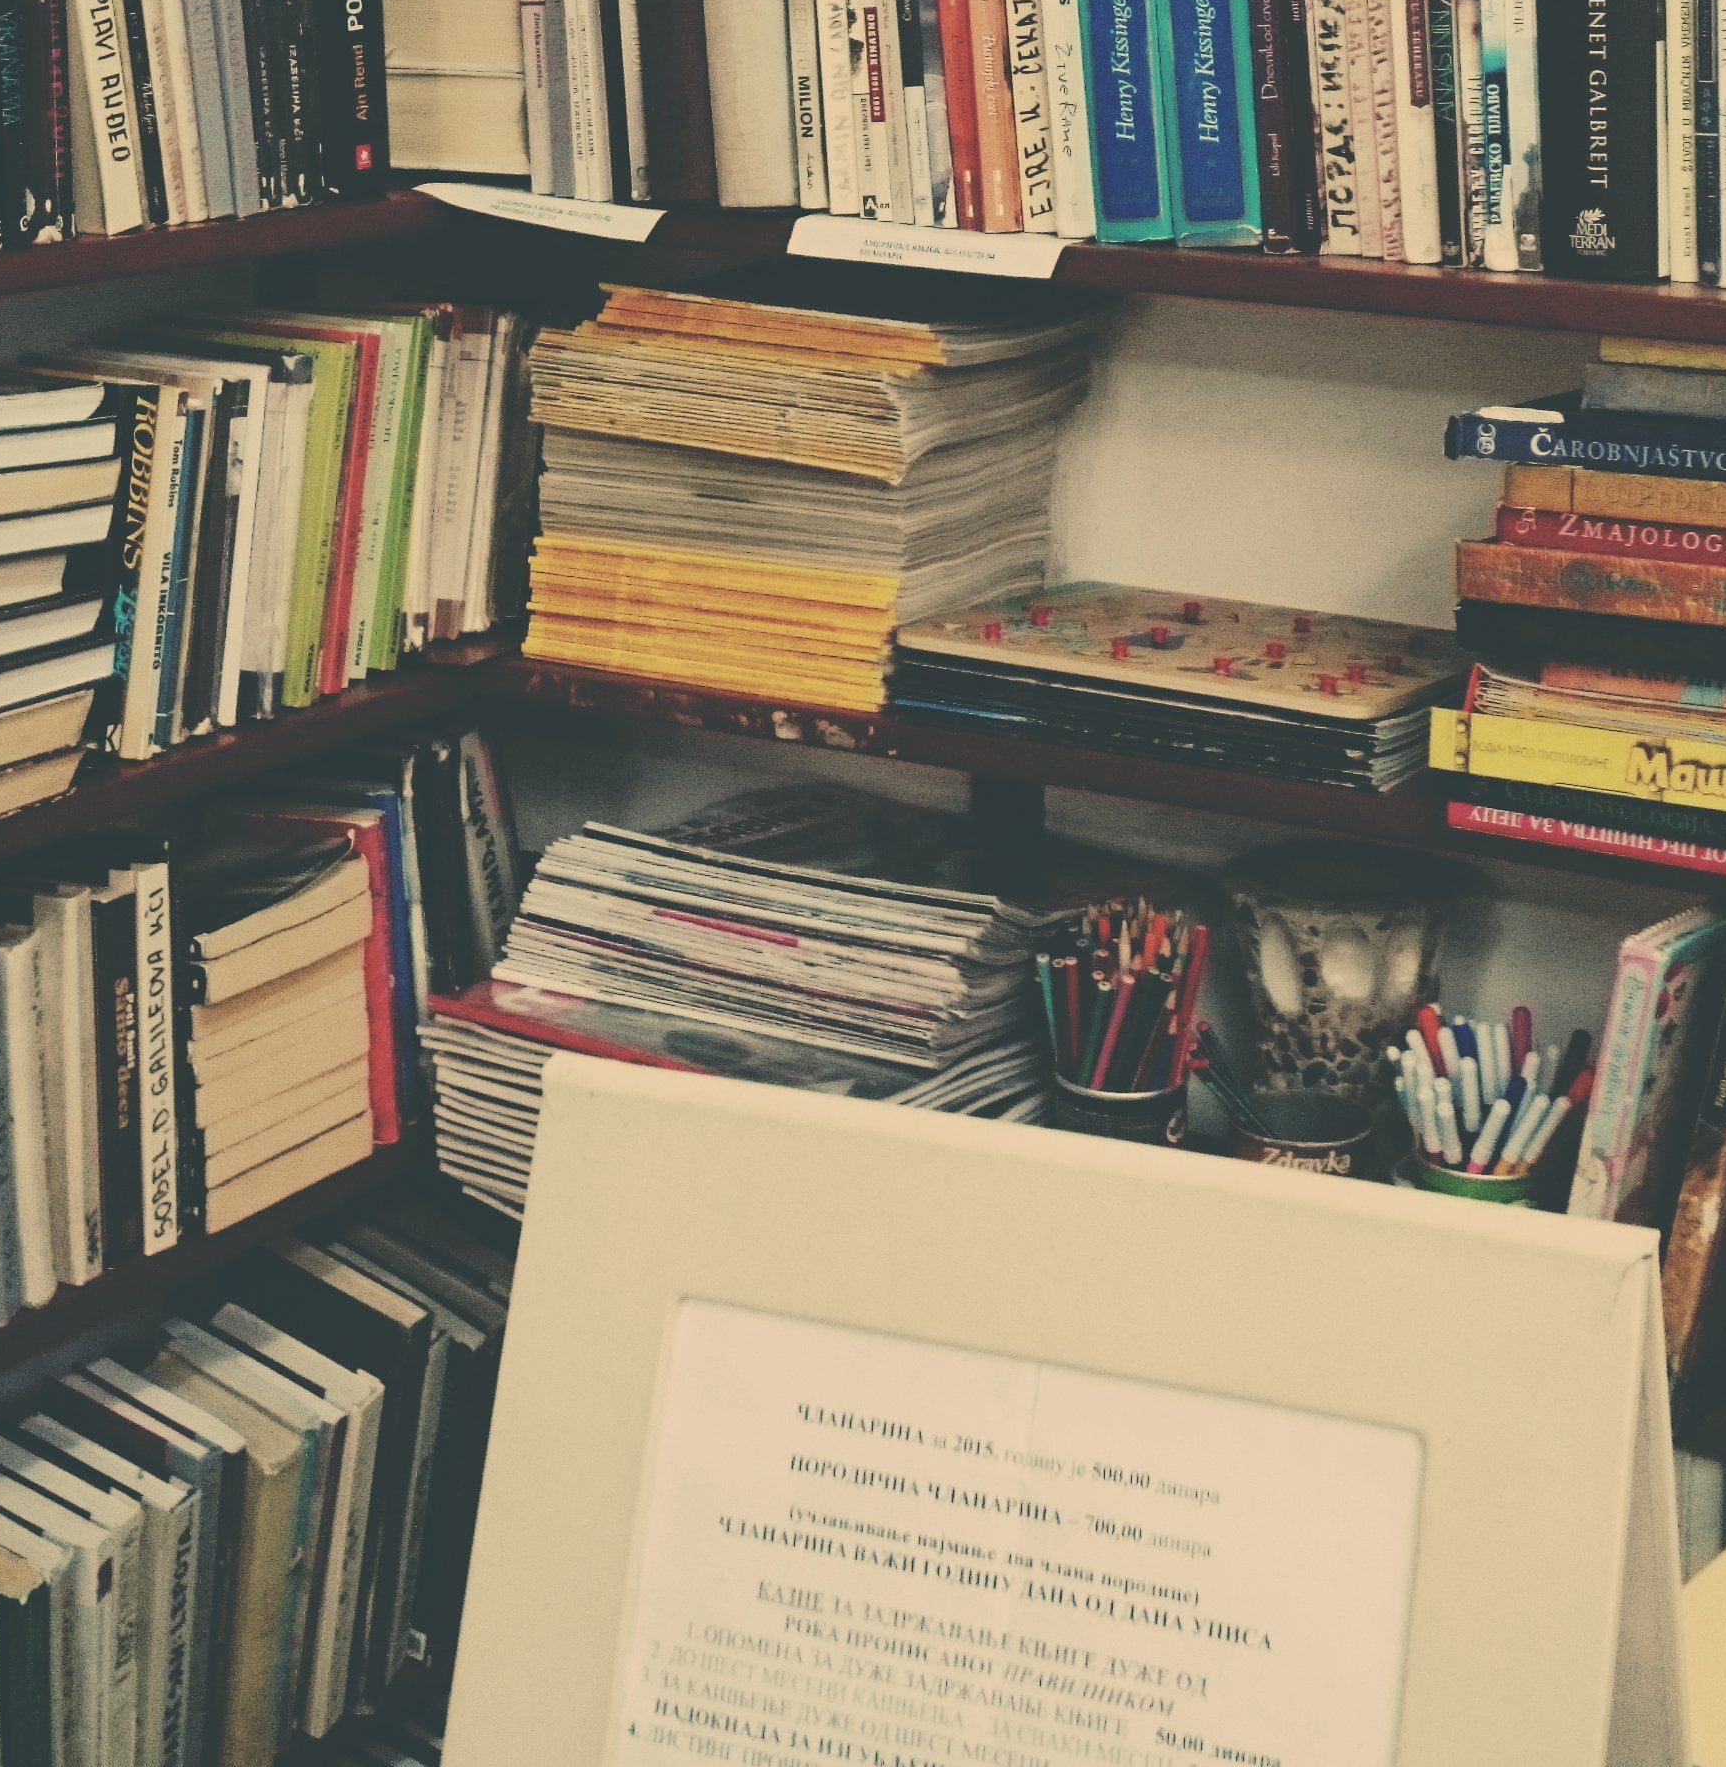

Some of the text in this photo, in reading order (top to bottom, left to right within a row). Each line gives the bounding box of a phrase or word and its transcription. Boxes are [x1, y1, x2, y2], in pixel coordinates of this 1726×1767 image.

[866, 13, 879, 67] DNEVNIK
[1257, 23, 1272, 41] od
[351, 44, 366, 87] Rend
[1256, 45, 1275, 100] Dnevnik
[354, 92, 370, 119] Ajn
[796, 73, 816, 139] MILION
[1587, 70, 1607, 188] GALBREJT
[122, 396, 158, 571] ROBBINS
[1467, 802, 1524, 828] ДЕЦУ
[1526, 814, 1553, 833] ЗА
[789, 1453, 920, 1496] ПОРОДИЧНА
[929, 1482, 1062, 1526] ЧЛАНАРИНА
[1085, 1514, 1143, 1541] 700,00
[719, 1515, 1273, 1651] ЧЛАНАРИНА ВАЖИ ГОДИНУ ДАНА ОД ДАНА УПИСА
[784, 1613, 839, 1643] РОКА
